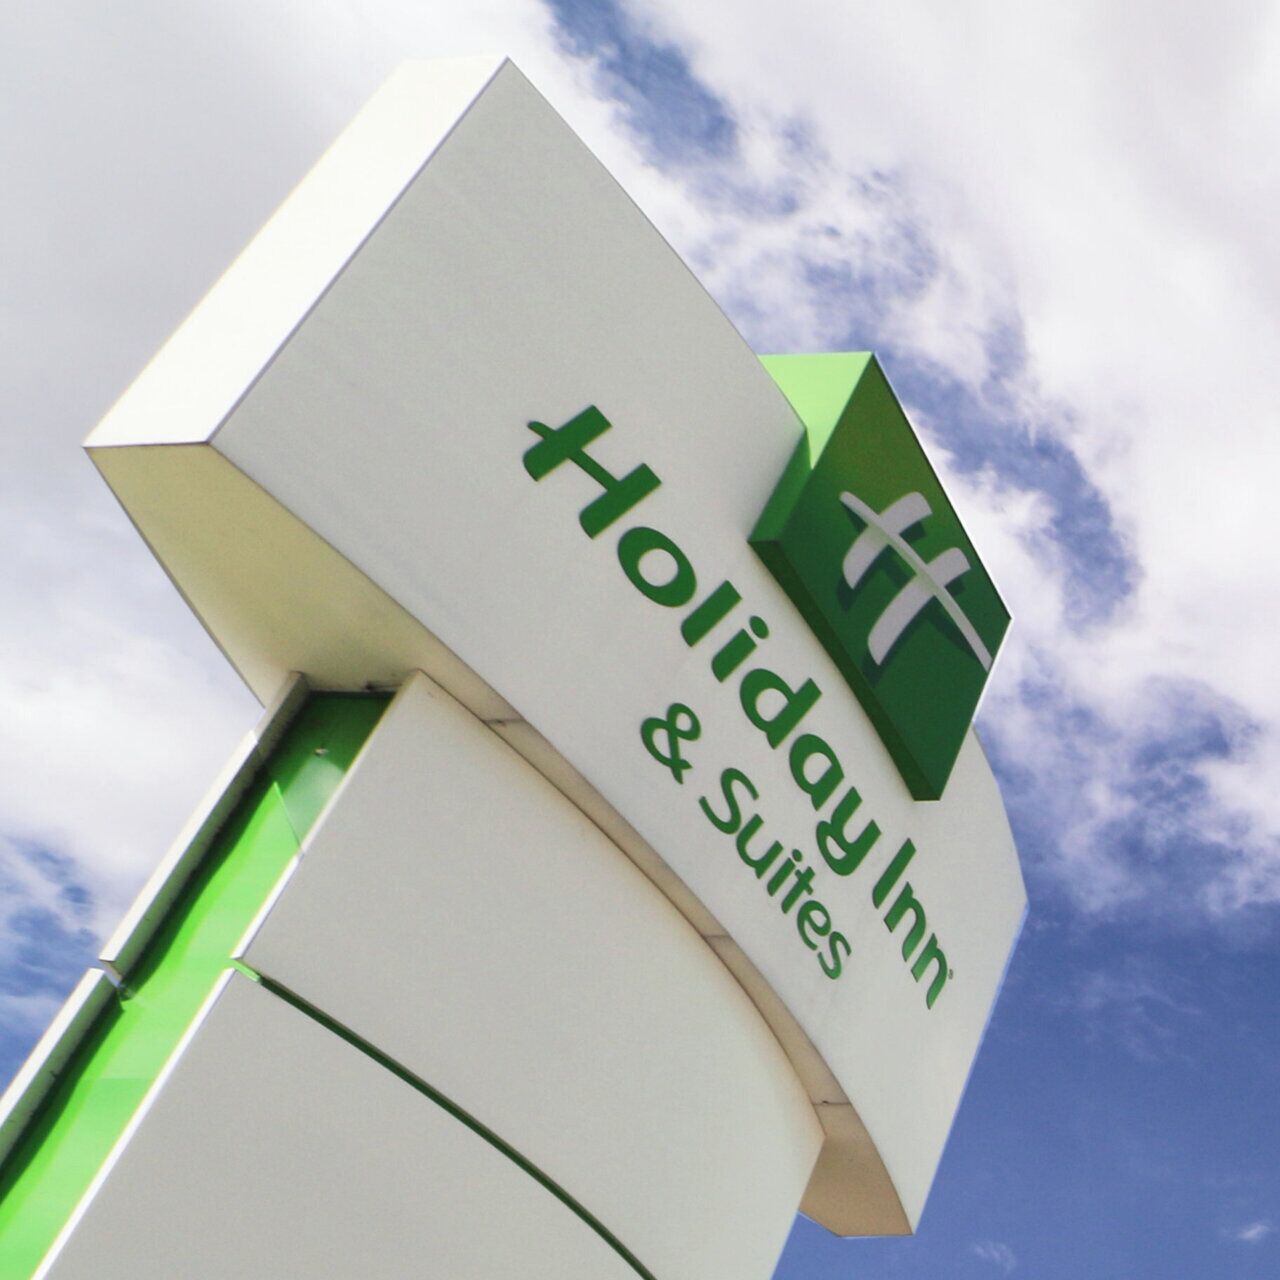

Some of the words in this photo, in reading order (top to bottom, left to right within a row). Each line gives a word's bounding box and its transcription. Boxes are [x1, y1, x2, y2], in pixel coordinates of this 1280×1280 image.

[523, 405, 882, 877] Holiday
[872, 838, 949, 1009] Inn
[640, 702, 701, 785] &
[699, 768, 852, 980] Suites
